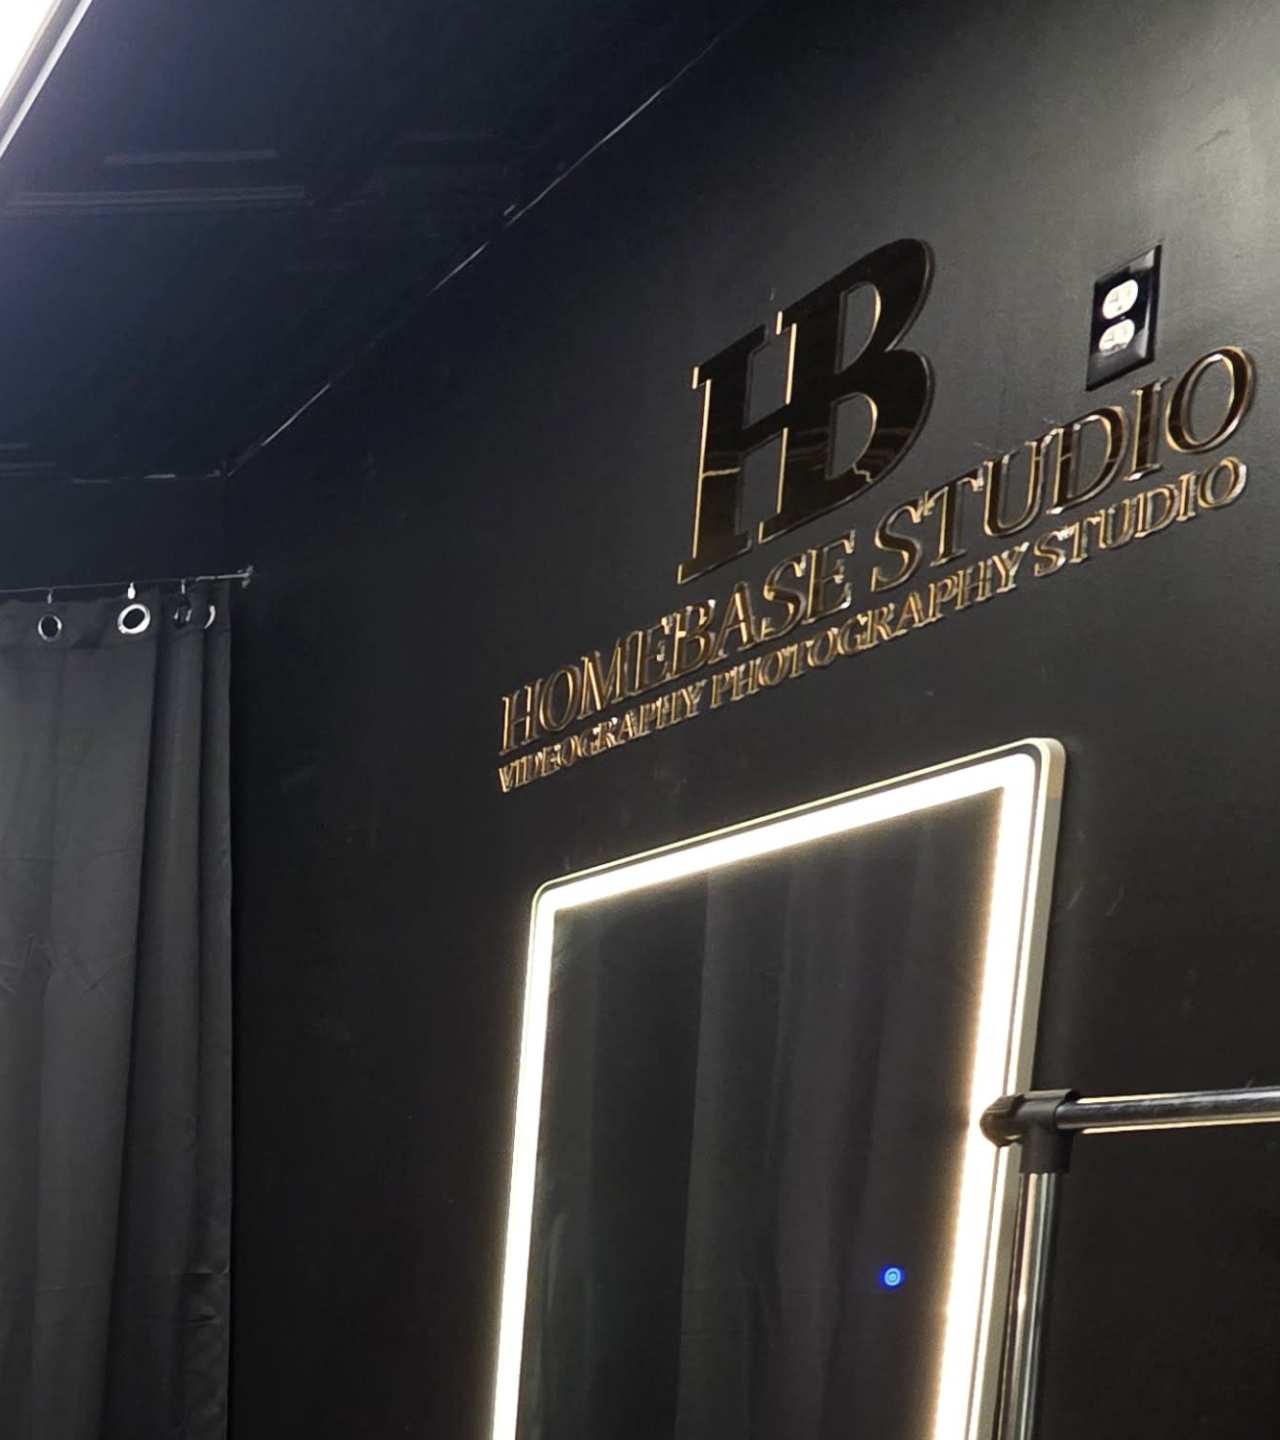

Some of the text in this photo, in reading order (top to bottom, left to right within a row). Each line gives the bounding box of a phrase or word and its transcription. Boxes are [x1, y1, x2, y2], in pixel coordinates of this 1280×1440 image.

[499, 346, 1258, 755] HOMEBASE STUDIO
[677, 238, 935, 584] HB
[498, 456, 1248, 793] VIDEOGRAPHY PHOTOGRAPHY STUDIO
